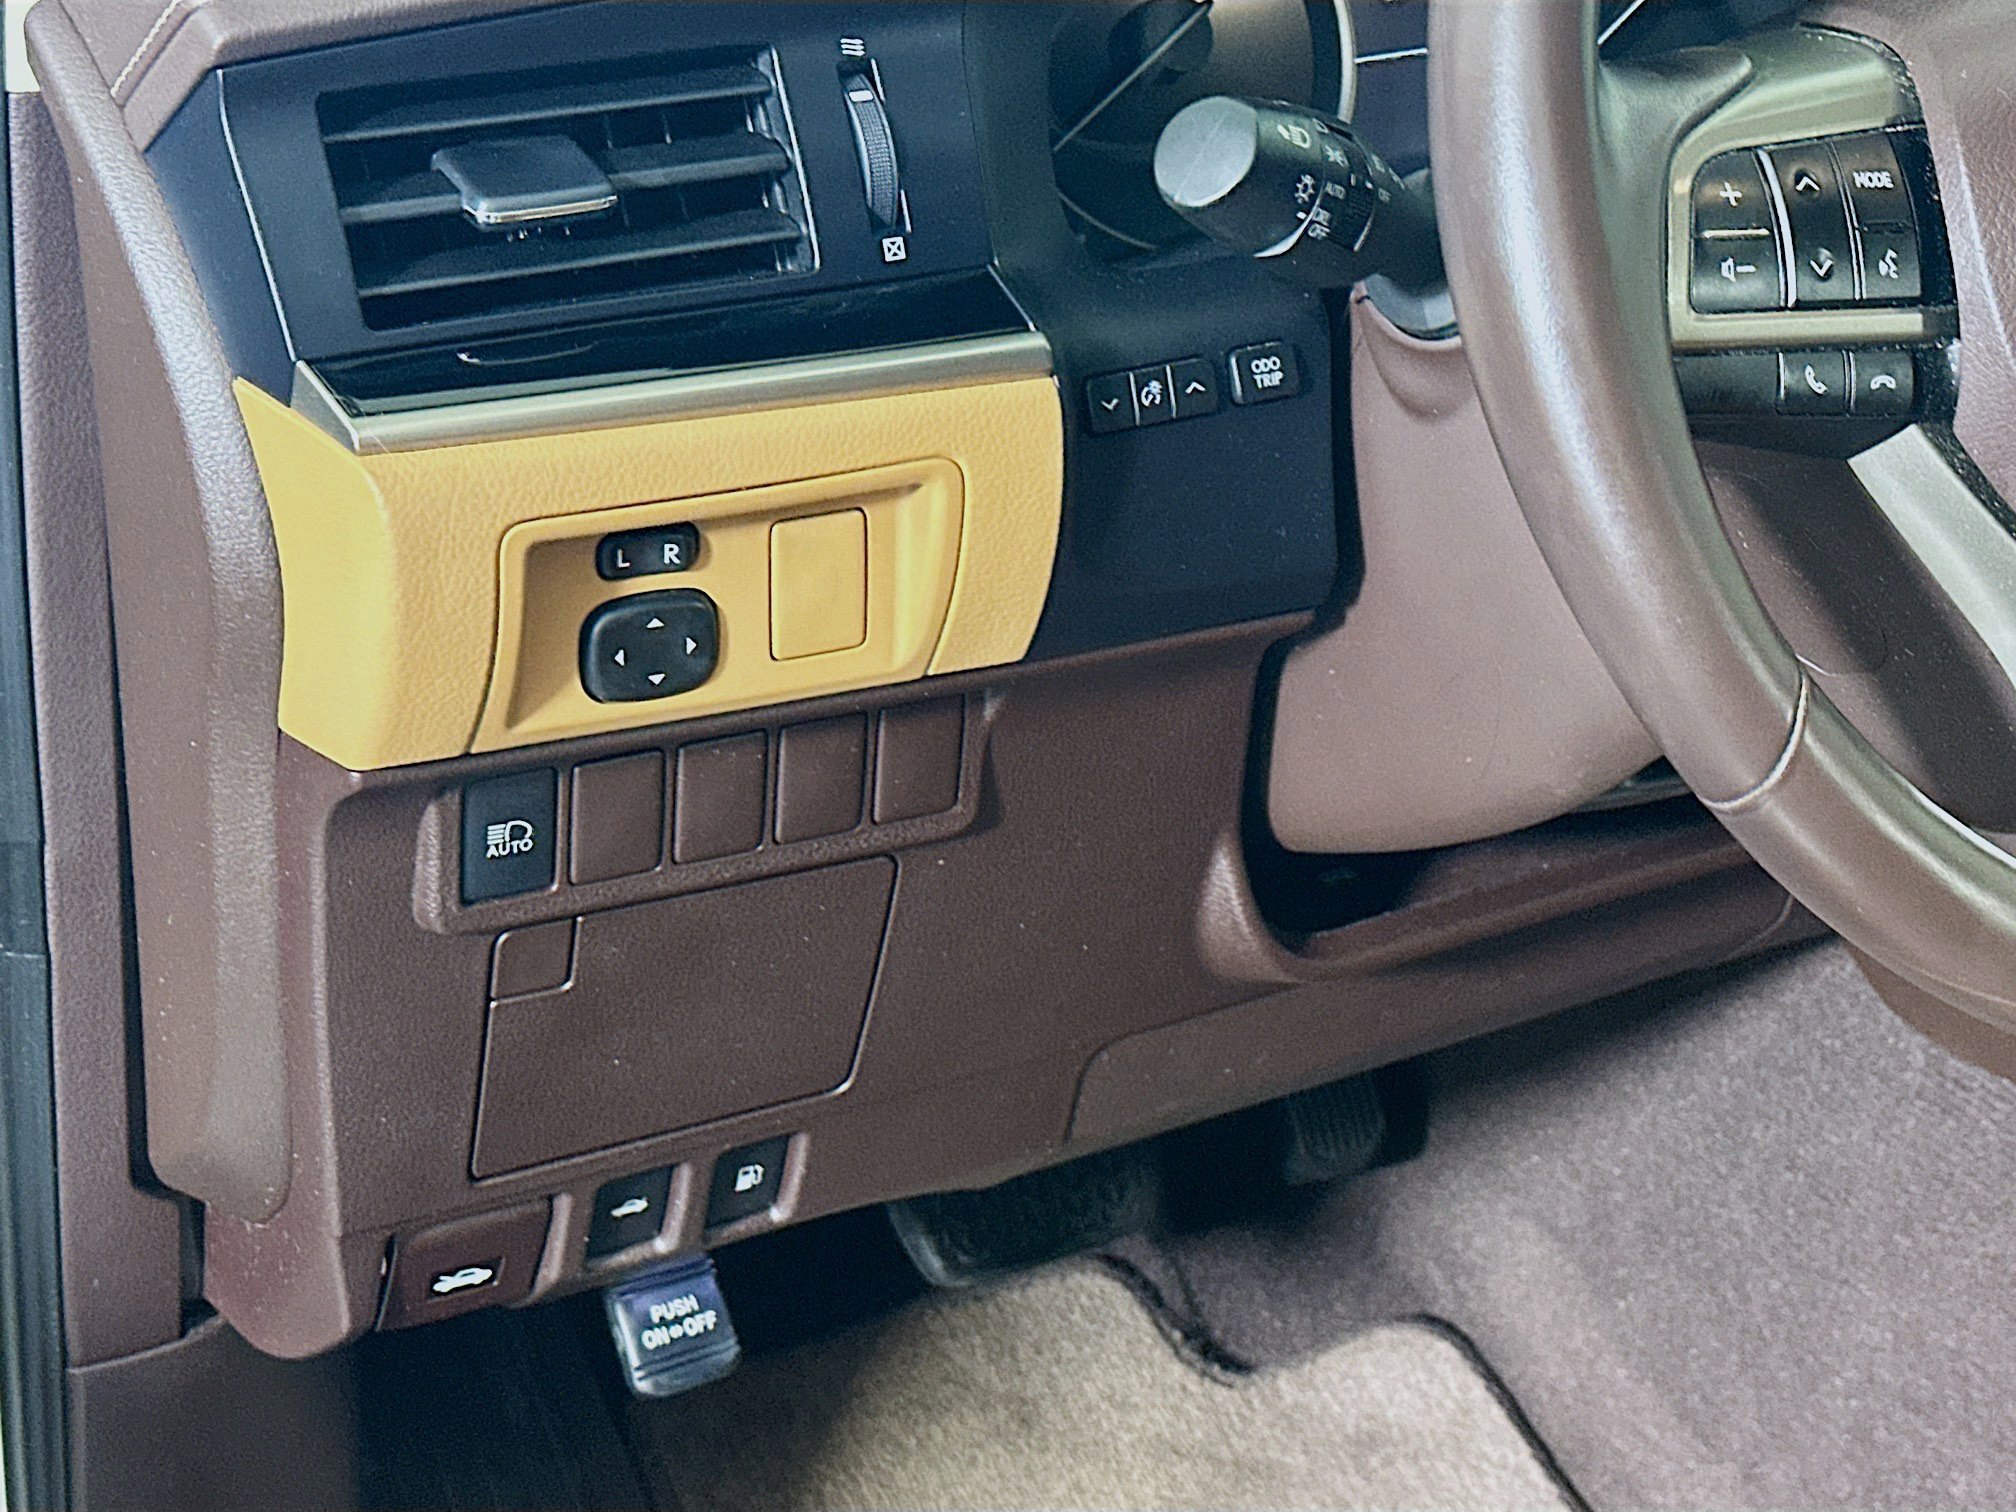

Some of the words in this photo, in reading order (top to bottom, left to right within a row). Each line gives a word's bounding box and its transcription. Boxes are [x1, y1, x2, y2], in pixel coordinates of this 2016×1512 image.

[1852, 170, 1895, 189] MODE
[1307, 222, 1332, 240] OFF
[1250, 356, 1281, 374] ODO
[1252, 370, 1284, 389] TRIP
[617, 548, 631, 568] L
[663, 543, 681, 565] R
[486, 838, 533, 859] AUTO
[649, 1293, 700, 1324] PUSH
